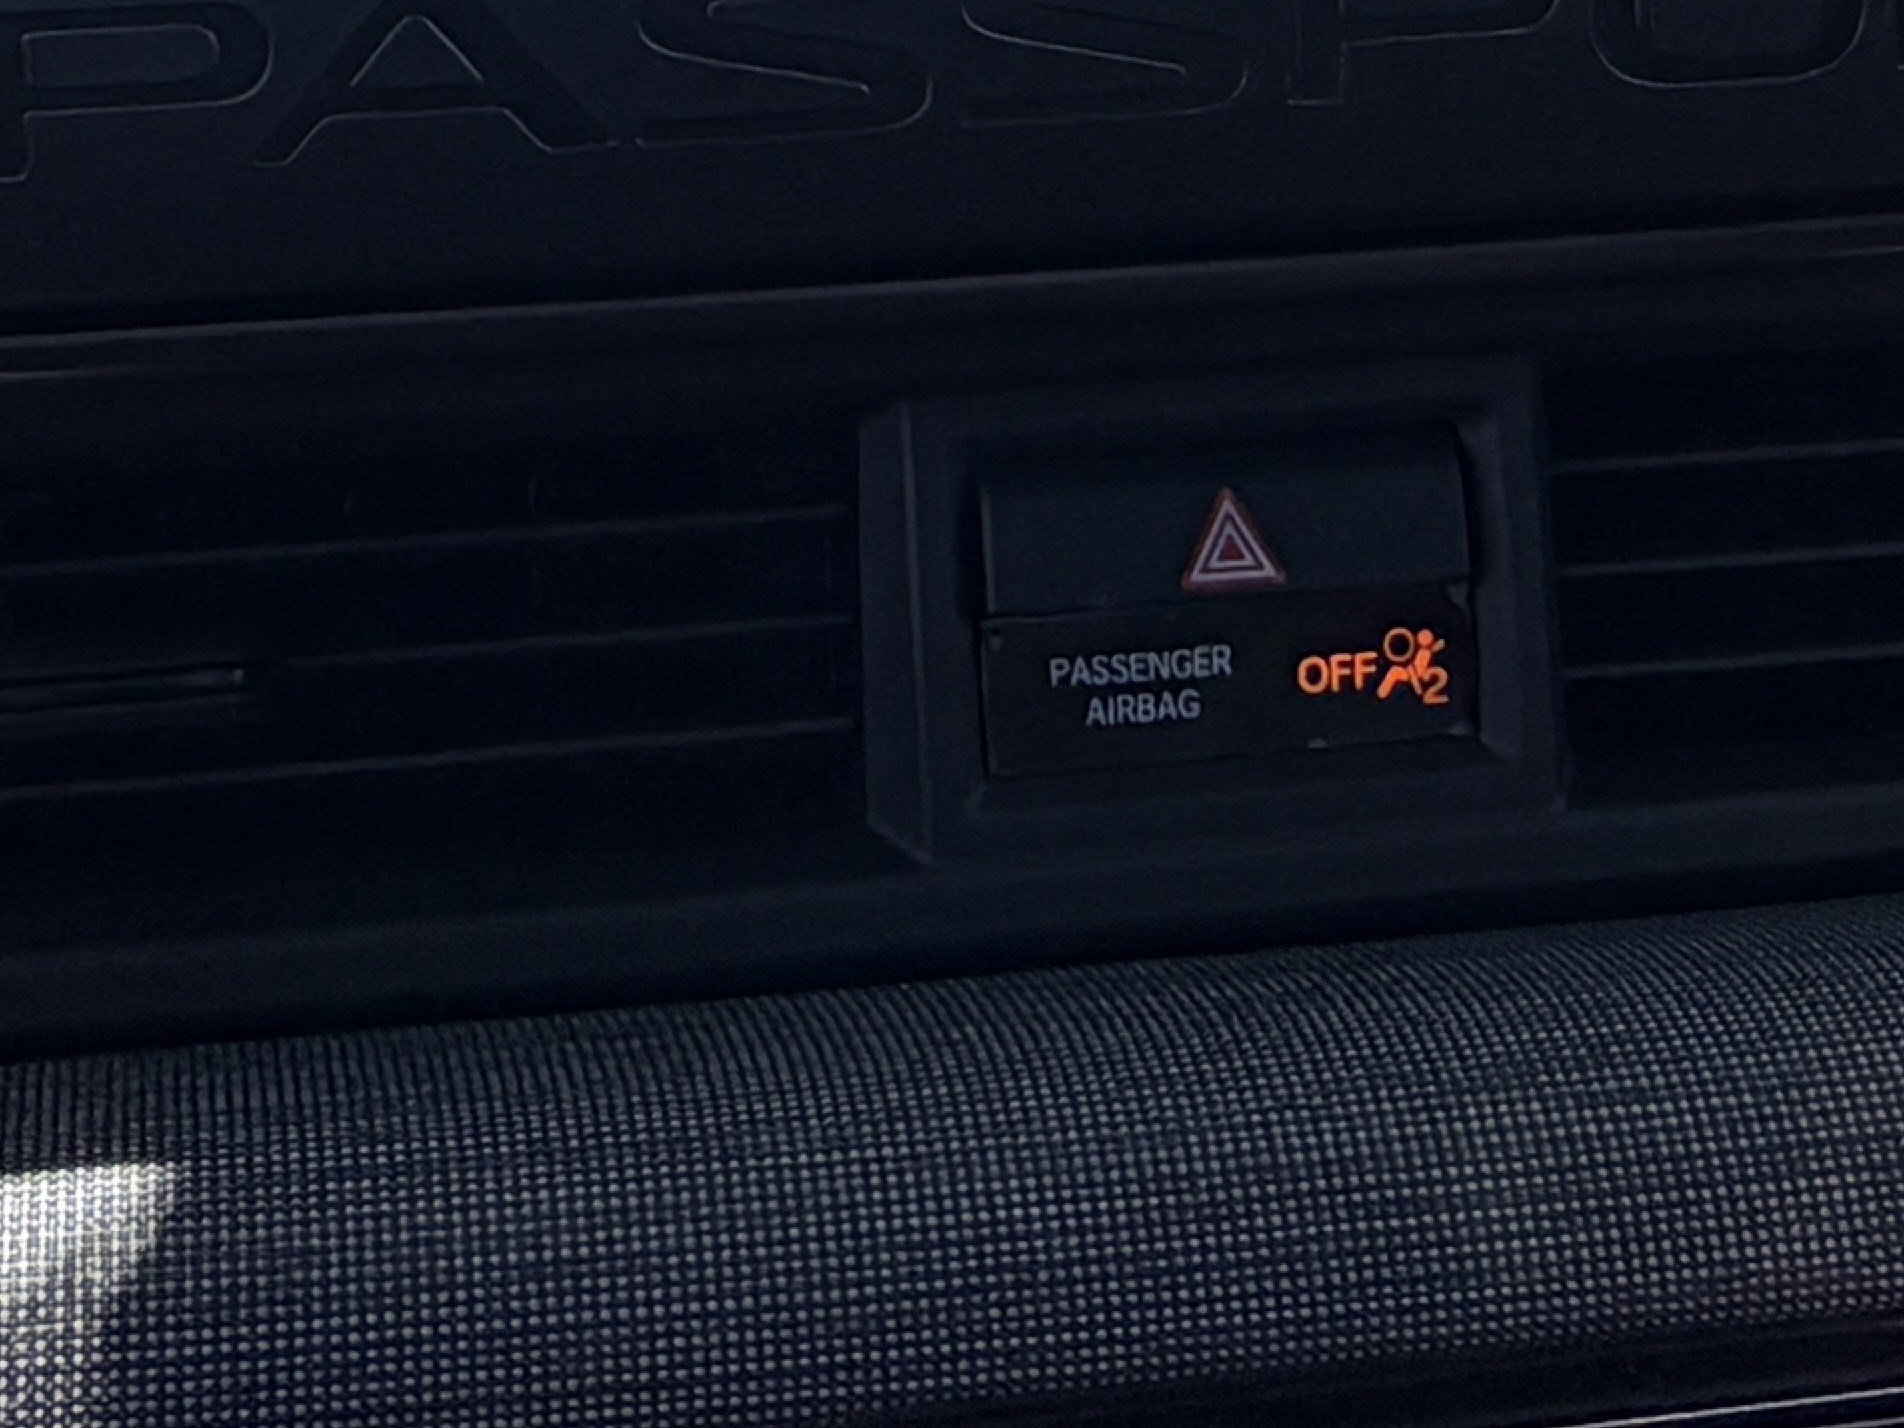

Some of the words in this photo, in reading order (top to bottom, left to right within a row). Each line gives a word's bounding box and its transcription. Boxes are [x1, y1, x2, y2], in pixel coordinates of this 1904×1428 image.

[1050, 644, 1232, 688] PASSENGER
[1298, 651, 1378, 694] OFF
[1086, 688, 1201, 726] AIRBAG
